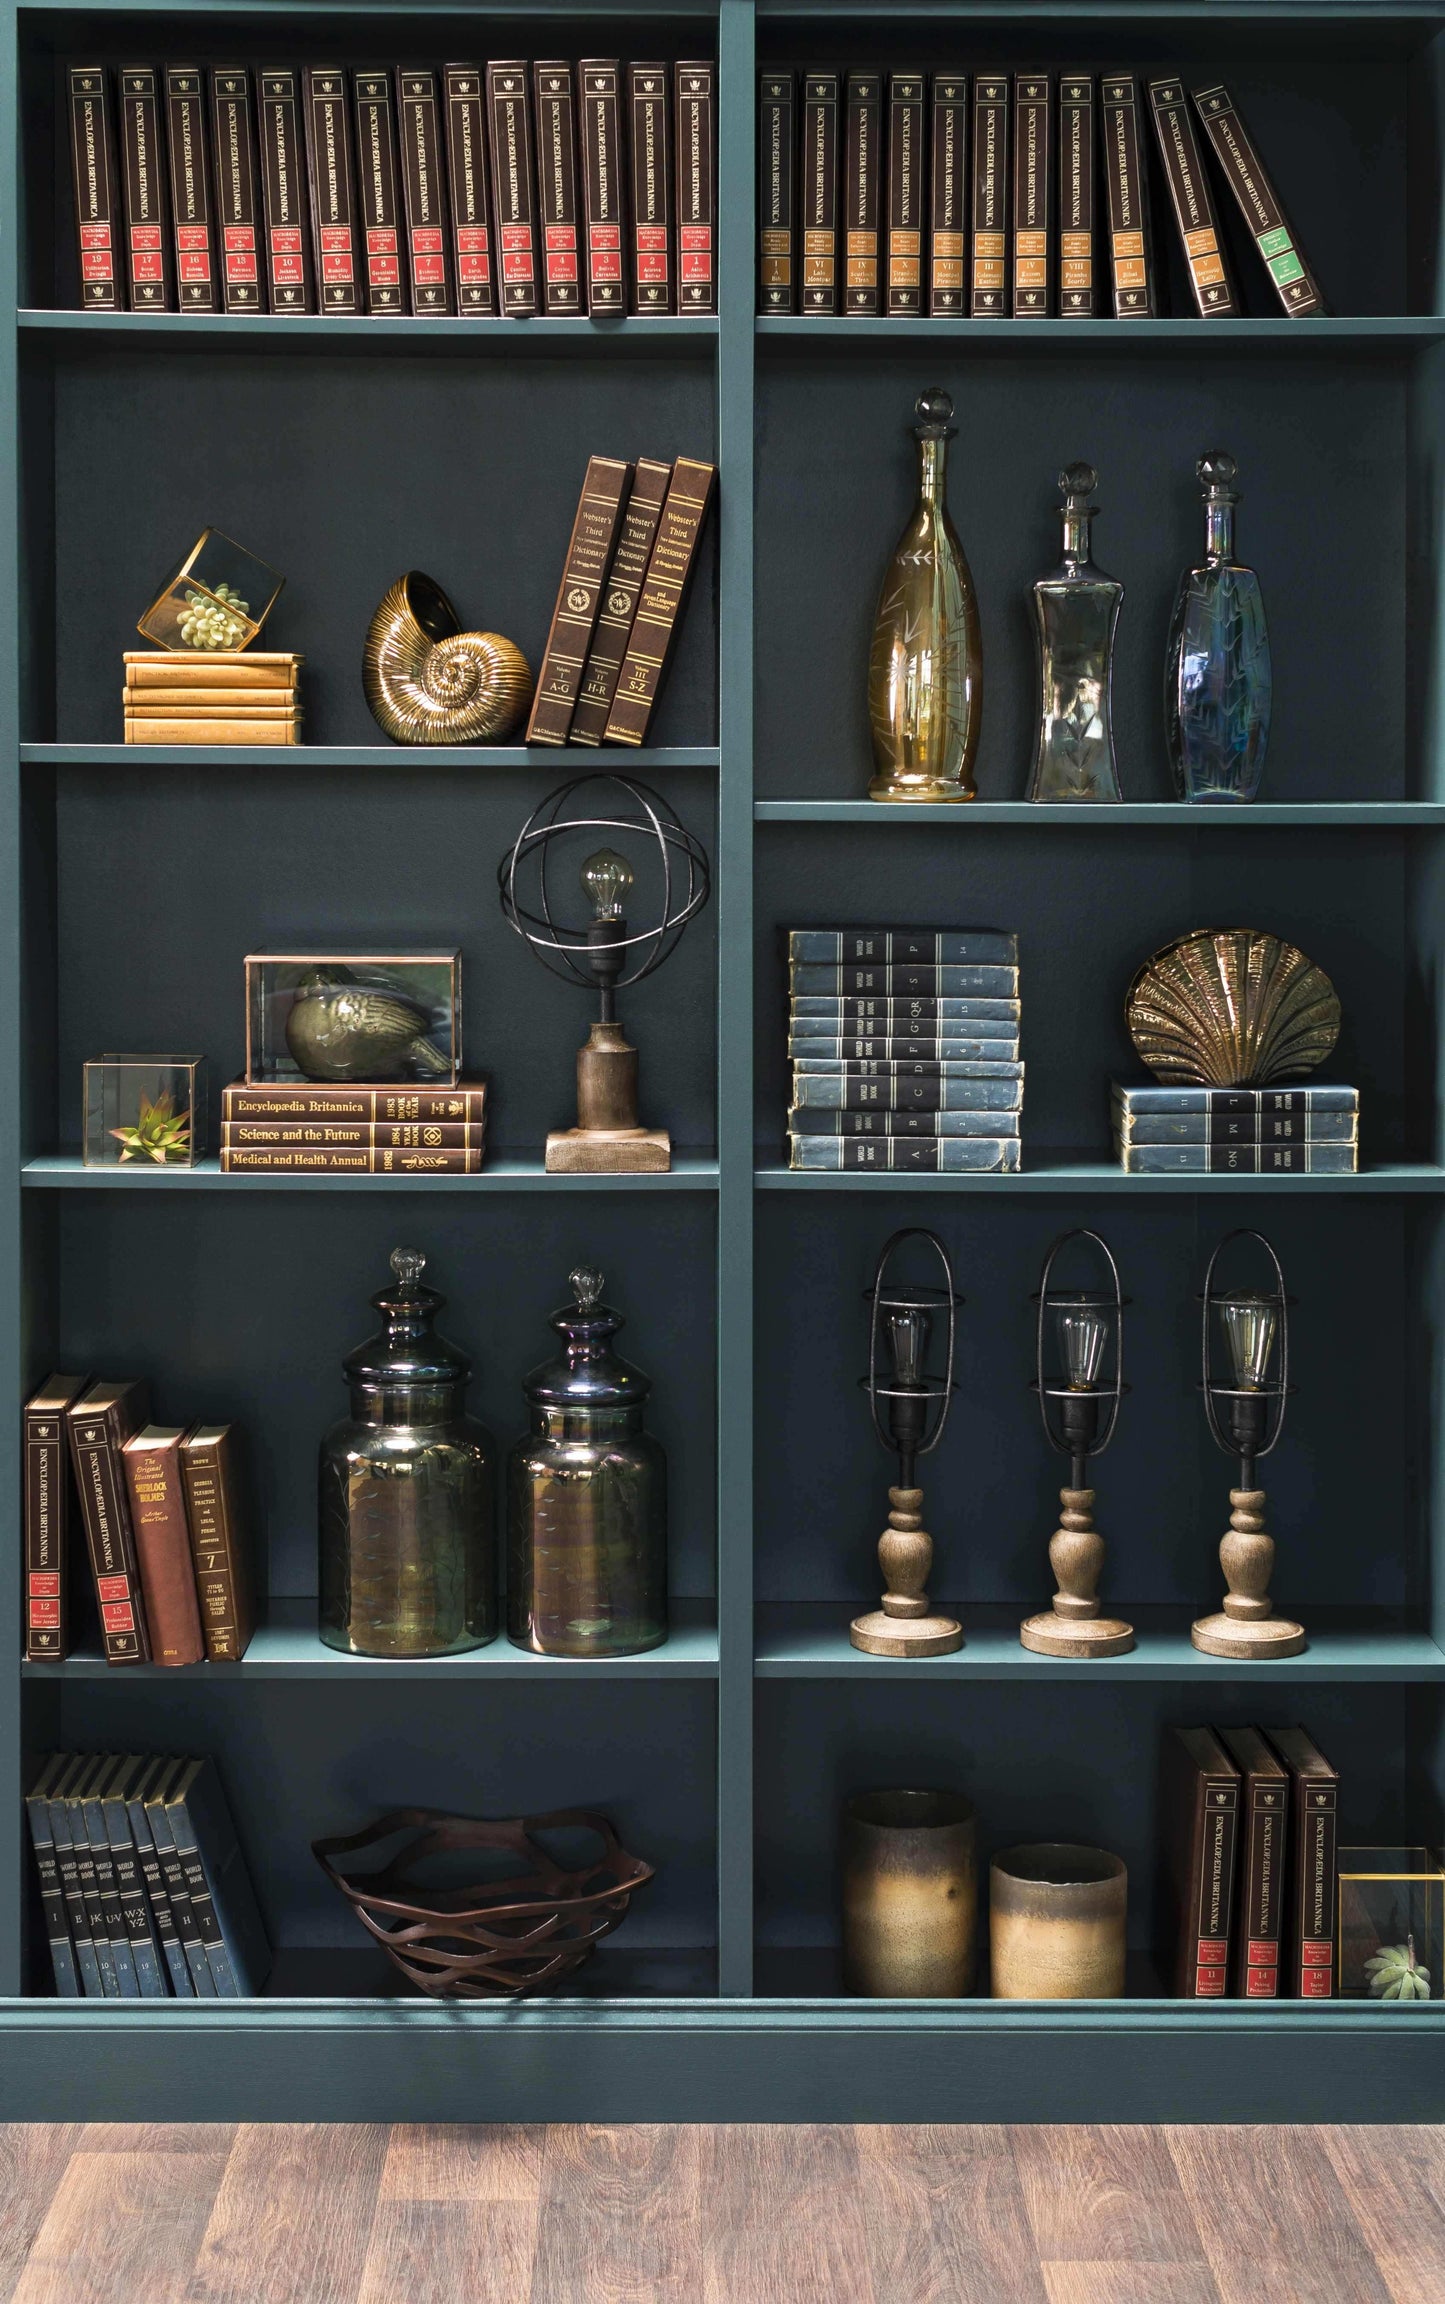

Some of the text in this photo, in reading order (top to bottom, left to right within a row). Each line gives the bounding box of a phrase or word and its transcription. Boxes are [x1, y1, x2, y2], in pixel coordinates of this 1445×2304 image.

[88, 167, 97, 217] BRITANNICA
[138, 167, 148, 218] BRITANNICA
[278, 170, 288, 221] BRITANNICA
[328, 169, 338, 220] BRITANNICA
[509, 167, 519, 219] BRITANNICA
[599, 167, 607, 218] BRITANNICA
[691, 168, 699, 219] BRITANNICA
[901, 173, 909, 224] BRITANNICA
[985, 174, 993, 225] BRITANNICA
[1182, 174, 1199, 224] BRITANNICA
[1244, 178, 1269, 226] BRITANNICA
[583, 512, 612, 524] Webster's
[626, 514, 655, 528] Webster's
[668, 513, 696, 526] Webster's
[586, 526, 602, 536] Third
[629, 529, 646, 539] Third
[670, 527, 687, 538] Third
[573, 545, 606, 559] Dictionary
[618, 548, 645, 562] Dictionary
[657, 545, 689, 560] Dictionary
[550, 682, 569, 692] A-G
[588, 683, 606, 694] H-R
[629, 681, 646, 692] S-Z
[309, 1101, 363, 1112] Britannica
[387, 1098, 395, 1117] 1983
[239, 1128, 360, 1140] Science and the Future
[1229, 1124, 1238, 1133] M
[392, 1128, 400, 1145] 1984
[233, 1154, 366, 1165] Medical and Health Annual
[384, 1151, 392, 1170] 1982
[136, 1482, 167, 1493] SHERLOCK
[140, 1492, 165, 1502] HOLMES
[99, 1517, 113, 1569] BRITANNICA
[208, 1555, 214, 1568] 7
[78, 1861, 93, 1870] WORLD
[81, 1871, 95, 1879] BOOK
[75, 1915, 82, 1923] E
[183, 1916, 191, 1924] H
[203, 1917, 210, 1926] T
[1208, 1970, 1215, 1978] 11
